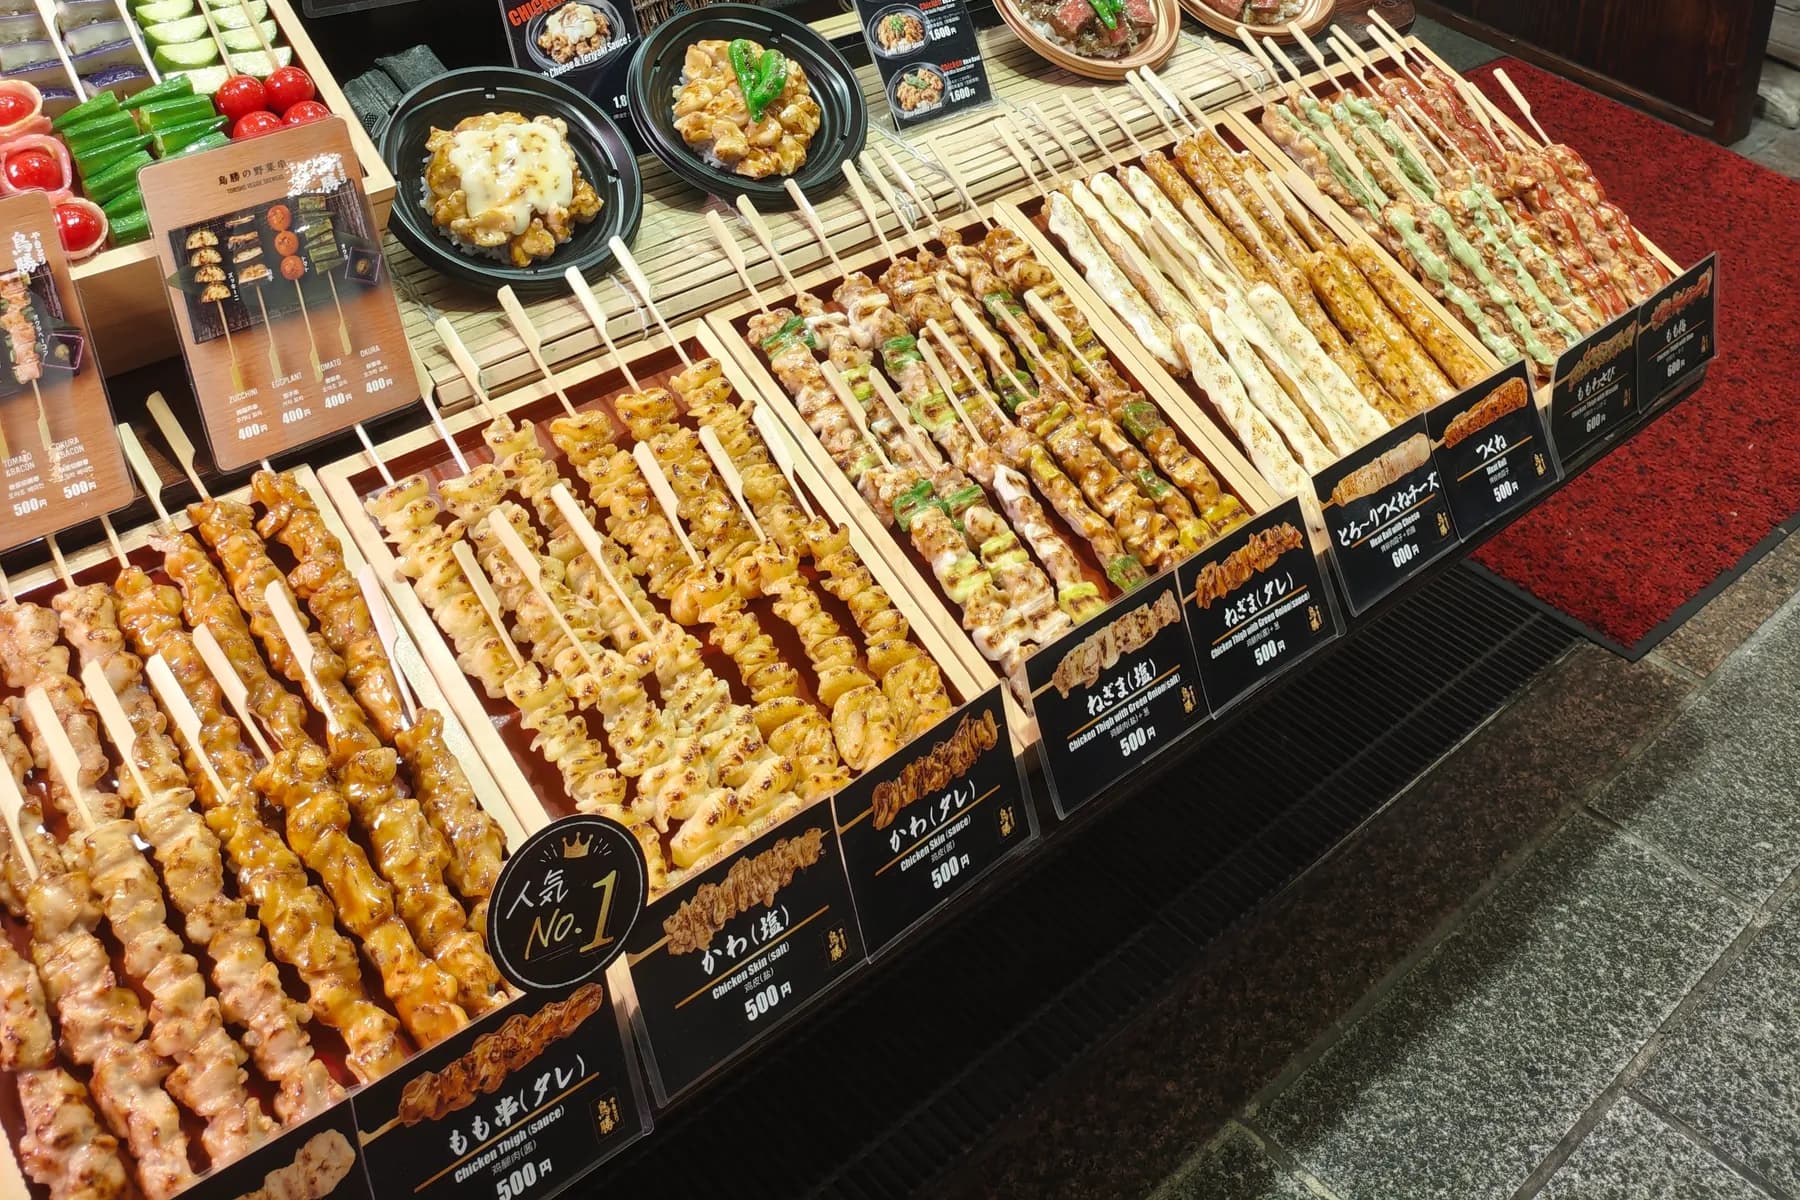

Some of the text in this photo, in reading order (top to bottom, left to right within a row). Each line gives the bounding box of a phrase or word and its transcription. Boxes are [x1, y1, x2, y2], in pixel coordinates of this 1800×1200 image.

[549, 37, 627, 79] Cheese Teriyaki Sauce
[360, 345, 381, 357] OKURA
[229, 388, 258, 404] ZUCCHINI
[272, 372, 302, 388] EGGPLANT
[325, 392, 353, 409] 400円
[366, 377, 393, 394] 400円
[238, 423, 268, 440] 400円
[282, 407, 312, 424] 400円
[1476, 434, 1508, 460] つくね
[13, 497, 48, 516] 500円
[64, 480, 96, 499] 500円
[1224, 572, 1293, 628] ねぎま(タレ)
[1211, 639, 1233, 659] Chicken
[1232, 629, 1248, 645] Thigh
[1246, 621, 1259, 635] with
[1258, 612, 1275, 628] Green
[1087, 658, 1156, 716] ねぎま(塩)
[1069, 729, 1096, 753] Chicken
[1095, 718, 1115, 737] Thigh
[1114, 706, 1128, 723] with
[1128, 695, 1148, 713] Green
[890, 780, 975, 853] かわ(タレ)
[900, 814, 971, 872] Chicken Skin (sauce)
[506, 870, 571, 920] 人気
[524, 870, 617, 961] No.1
[701, 904, 790, 975] かわ(塩)
[712, 941, 790, 1000] Chicken Skin (salt)
[449, 1054, 585, 1156] もも串(タレ)
[454, 1104, 565, 1184] Chicken Thigh (sauce)
